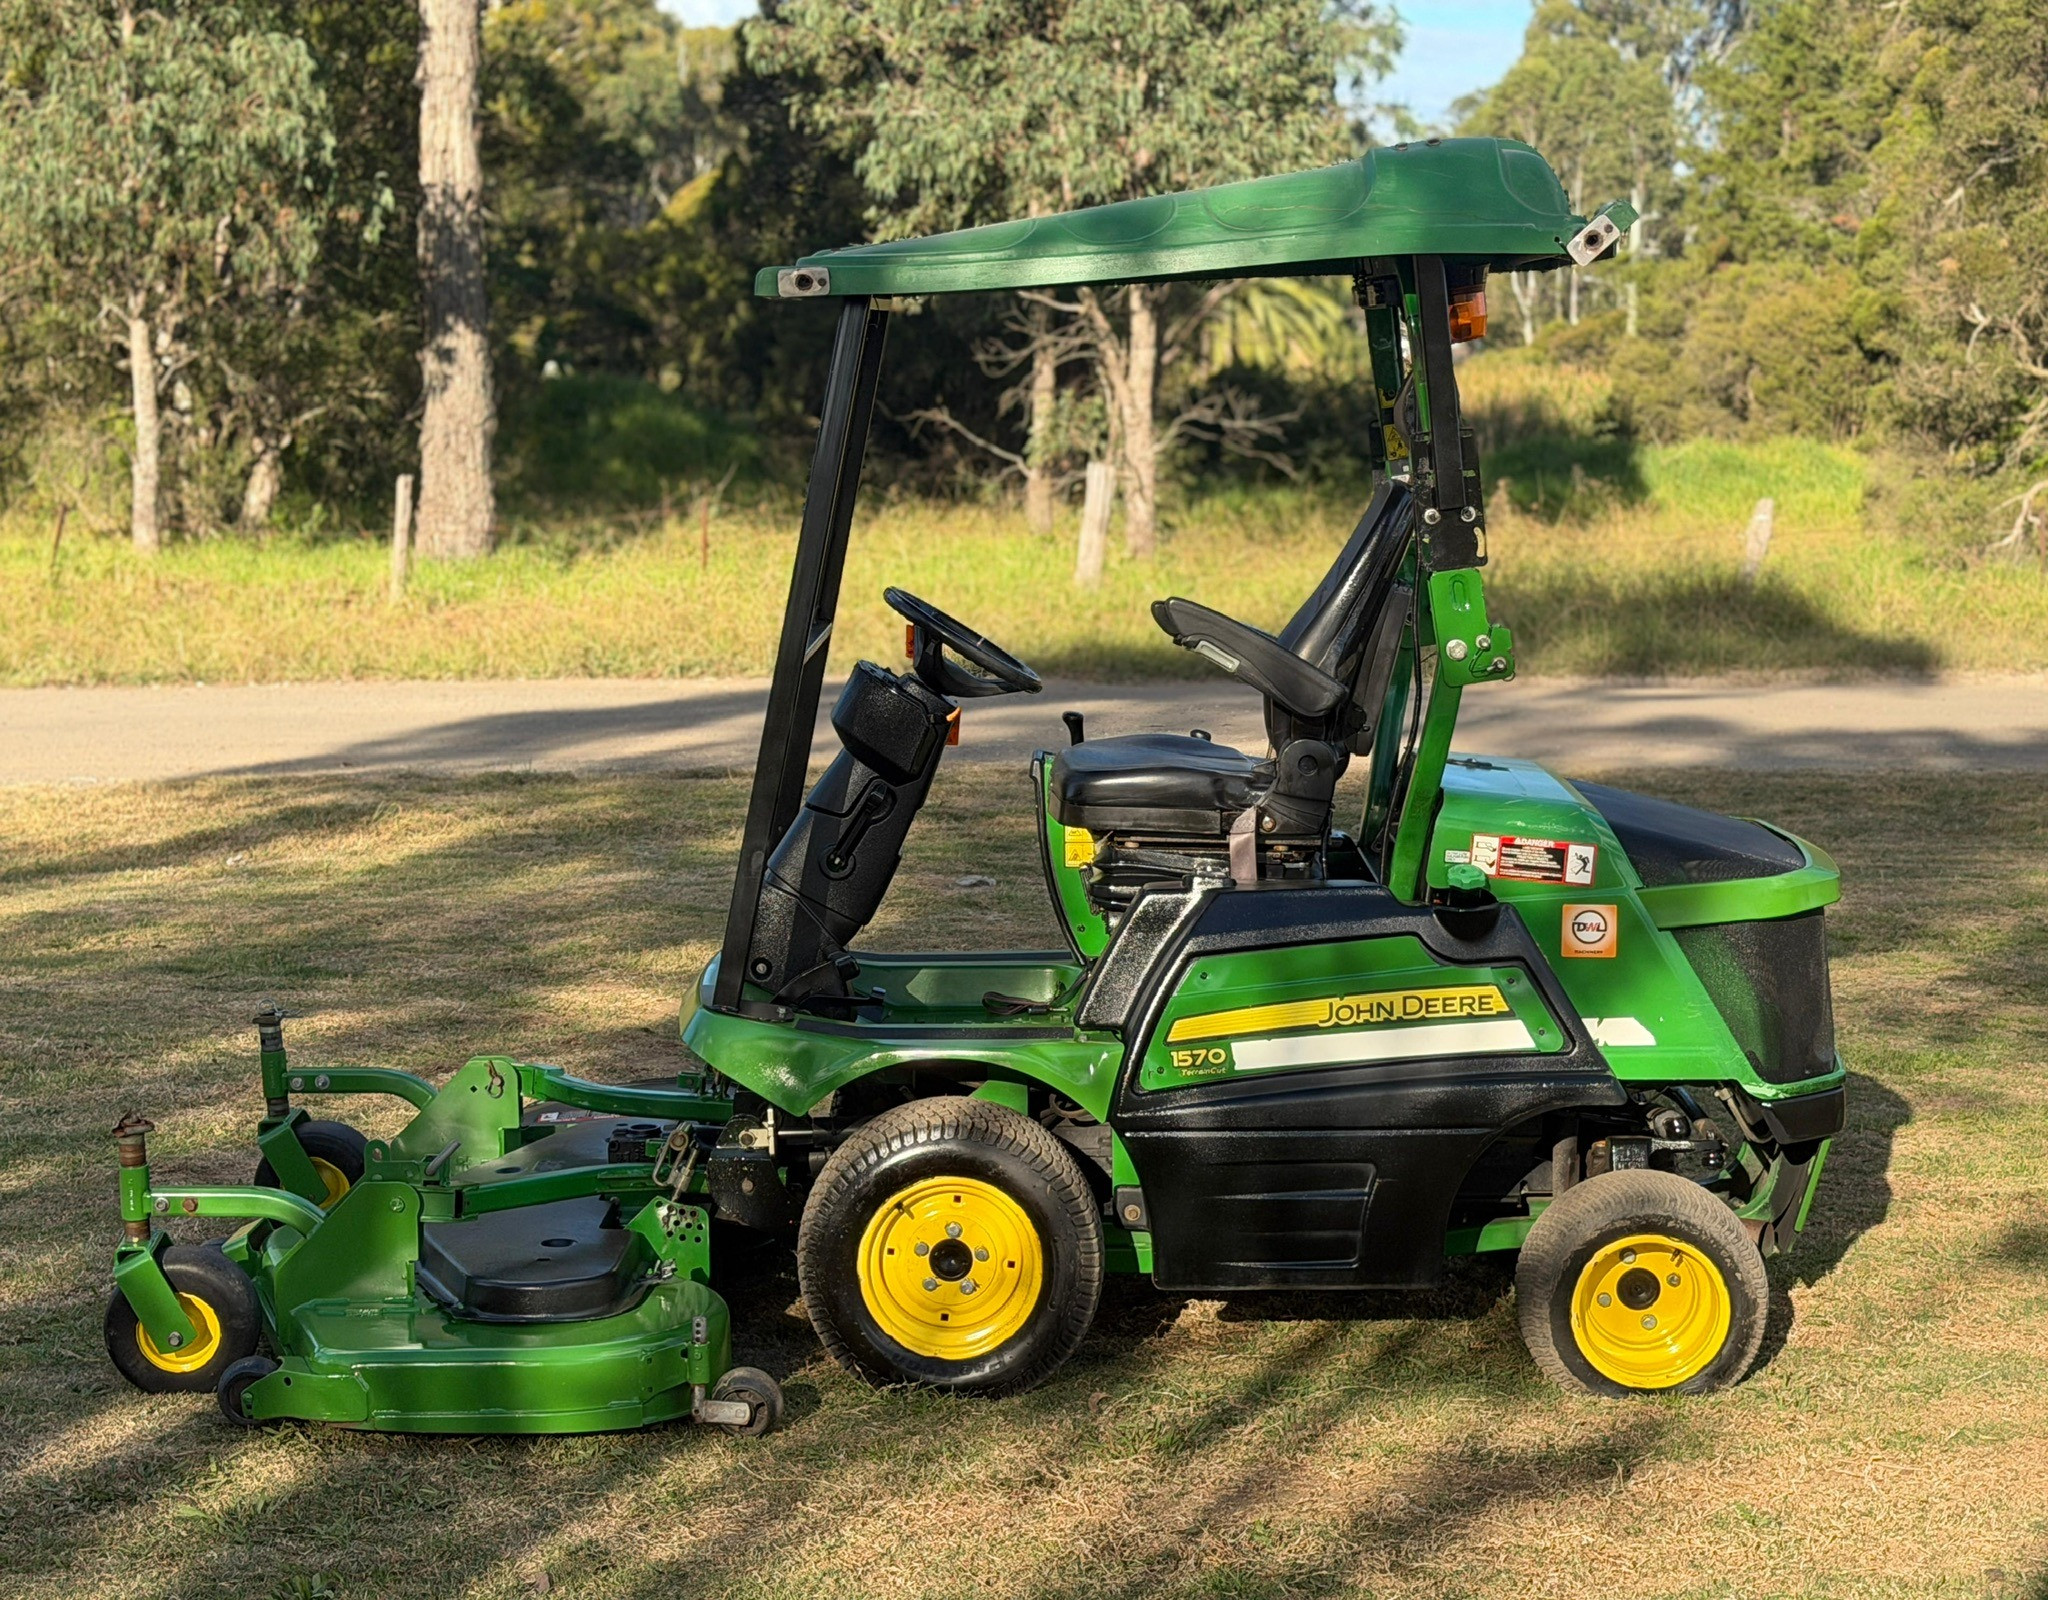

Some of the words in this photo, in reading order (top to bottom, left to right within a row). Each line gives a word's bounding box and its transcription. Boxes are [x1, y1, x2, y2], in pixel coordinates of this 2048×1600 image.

[1318, 1000, 1394, 1023] JOHN
[1402, 995, 1494, 1016] DEERE
[1170, 1048, 1227, 1067] 1570
